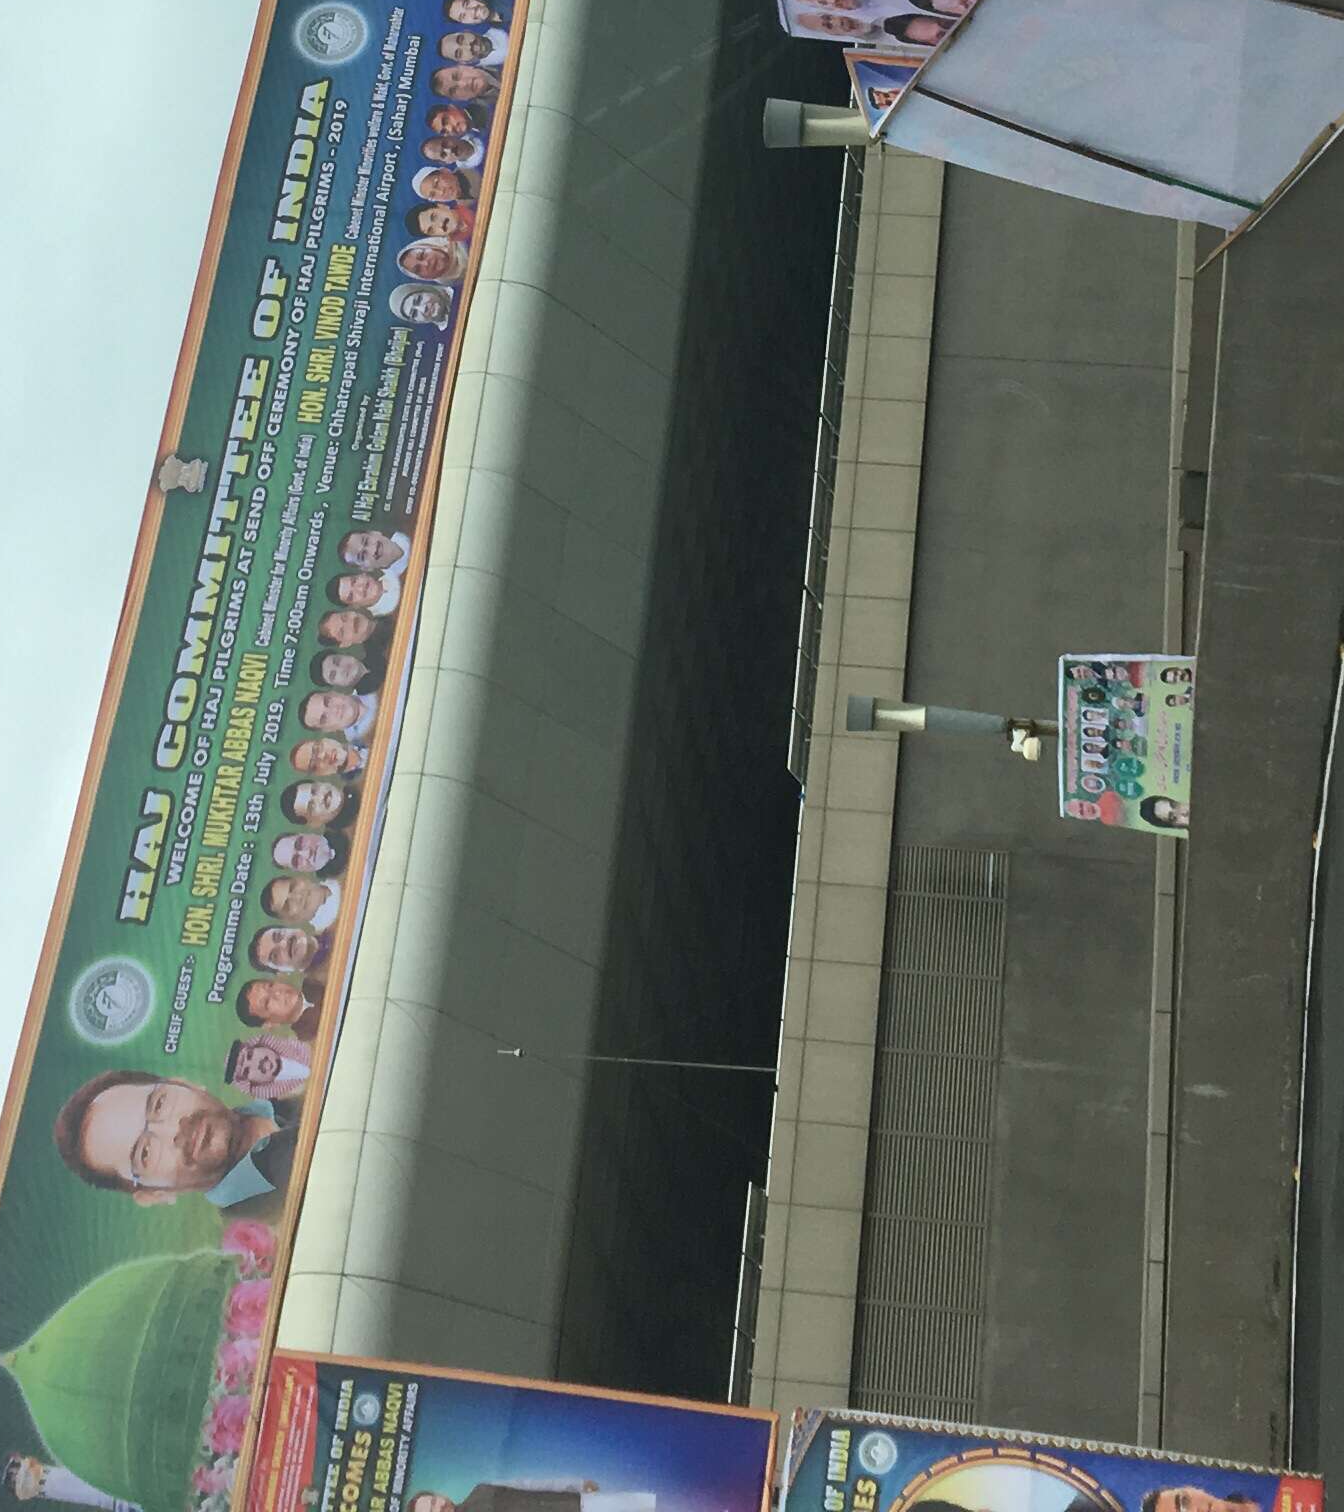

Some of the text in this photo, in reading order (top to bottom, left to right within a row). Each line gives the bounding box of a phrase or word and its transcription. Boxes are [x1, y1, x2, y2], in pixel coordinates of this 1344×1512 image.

[323, 245, 356, 293] TAWDE
[313, 296, 346, 341] VINOD
[304, 345, 336, 383] SHRI.
[376, 368, 400, 398] Shaikh
[296, 387, 328, 424] HON.
[351, 395, 371, 451] Organised by
[372, 399, 394, 421] Nabi
[365, 423, 390, 451] Gulam
[166, 100, 348, 885] WELCOME OF HAJ PILGRIMS AT SEND OFF CEREMONY OF HAJ PILGRIMS 2019
[357, 454, 383, 491] Ebrahim
[119, 80, 329, 921] HAJ COMMITTEE OF INDIA
[207, 36, 421, 1003] Programme Date 13th July 2019. Time 7:00am Onwards Venue: Chhatrapati Shivaji International Airport (Sahar) Mumbai
[351, 511, 371, 522] Al
[353, 492, 380, 509] Haj
[233, 654, 269, 703] NAQVI
[220, 708, 256, 762] ABBAS
[202, 766, 243, 847] MUKHTAR
[190, 852, 225, 898] SHRI.
[180, 903, 215, 945] HON.
[172, 967, 193, 1011] GUEST
[164, 1015, 183, 1053] CHEIF
[335, 1380, 353, 1430] INDIA
[373, 1383, 403, 1493] ABBAS NAQVI
[392, 1435, 410, 1494] MINORITY
[402, 1383, 418, 1432] AFFAIRS
[824, 1430, 850, 1511] OF INDIA
